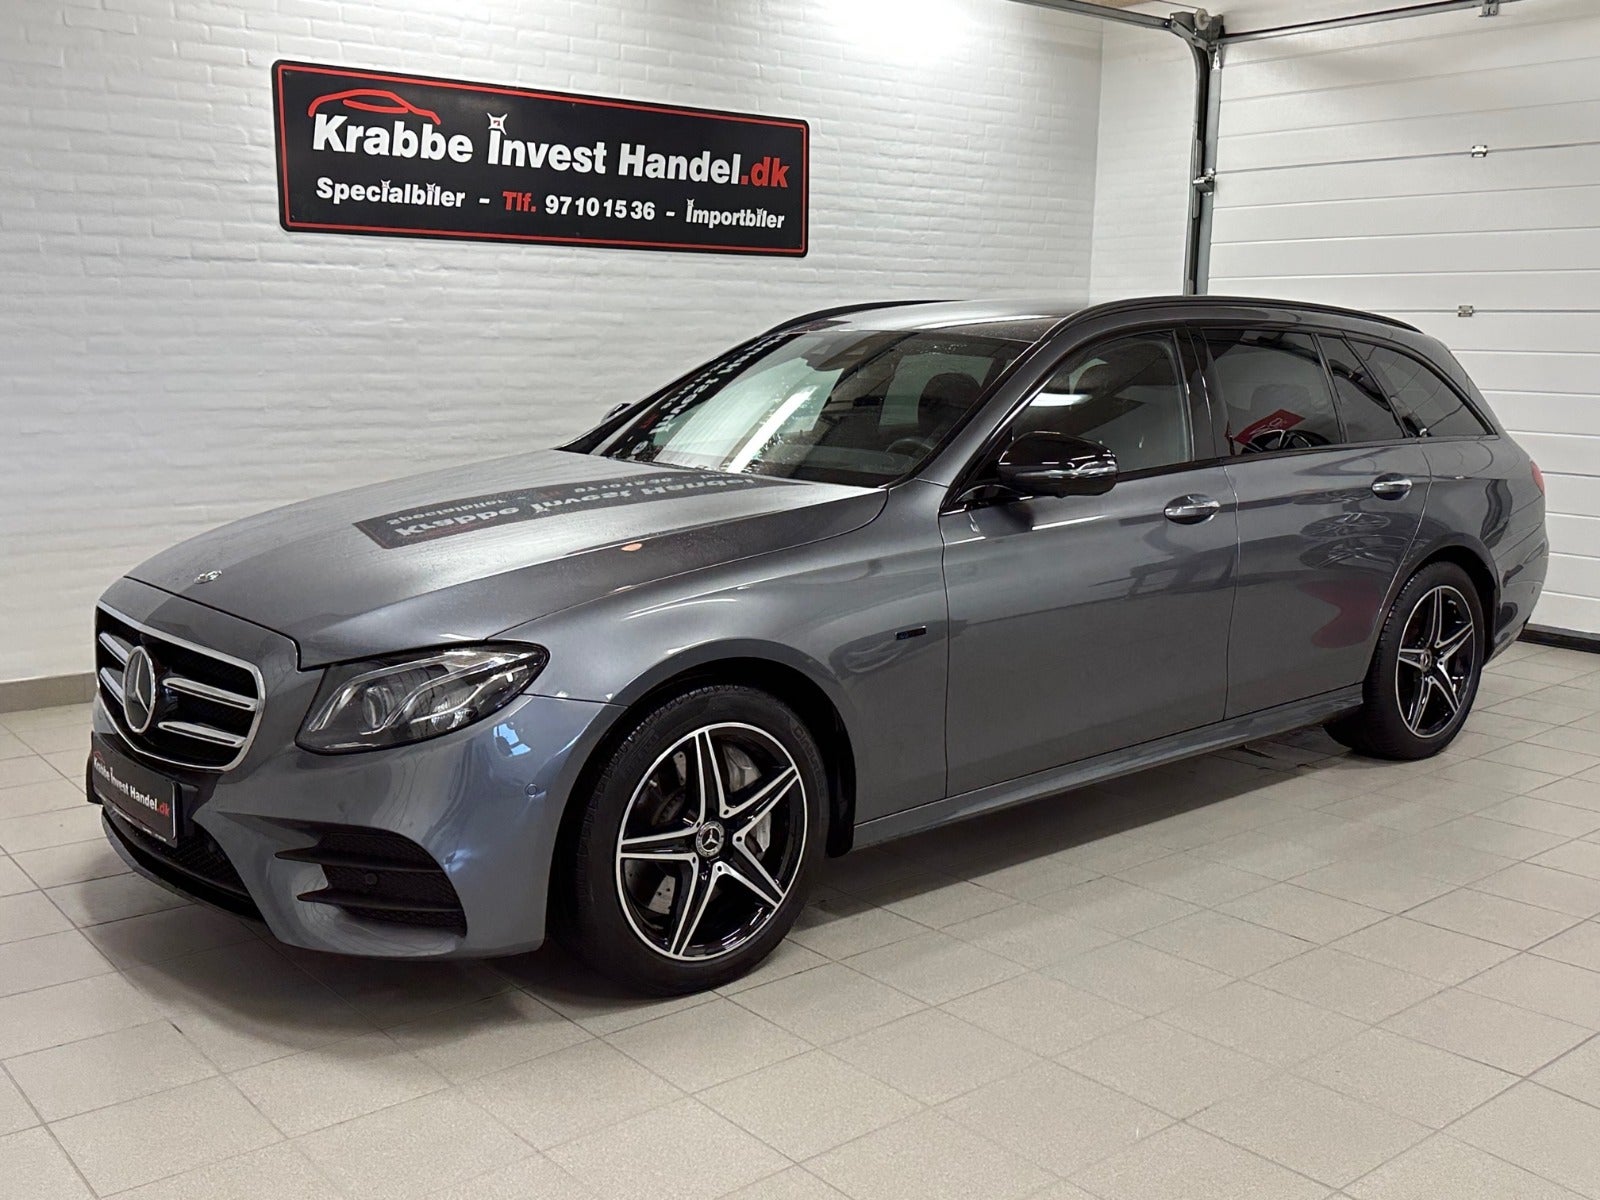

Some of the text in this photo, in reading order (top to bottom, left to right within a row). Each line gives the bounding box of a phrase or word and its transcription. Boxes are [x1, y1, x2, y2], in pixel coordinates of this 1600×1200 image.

[313, 113, 790, 188] Krabbe Invest Handel.dk
[316, 176, 466, 208] Specialbiler
[502, 190, 537, 213] Tlf.
[685, 198, 785, 229] Importbiler
